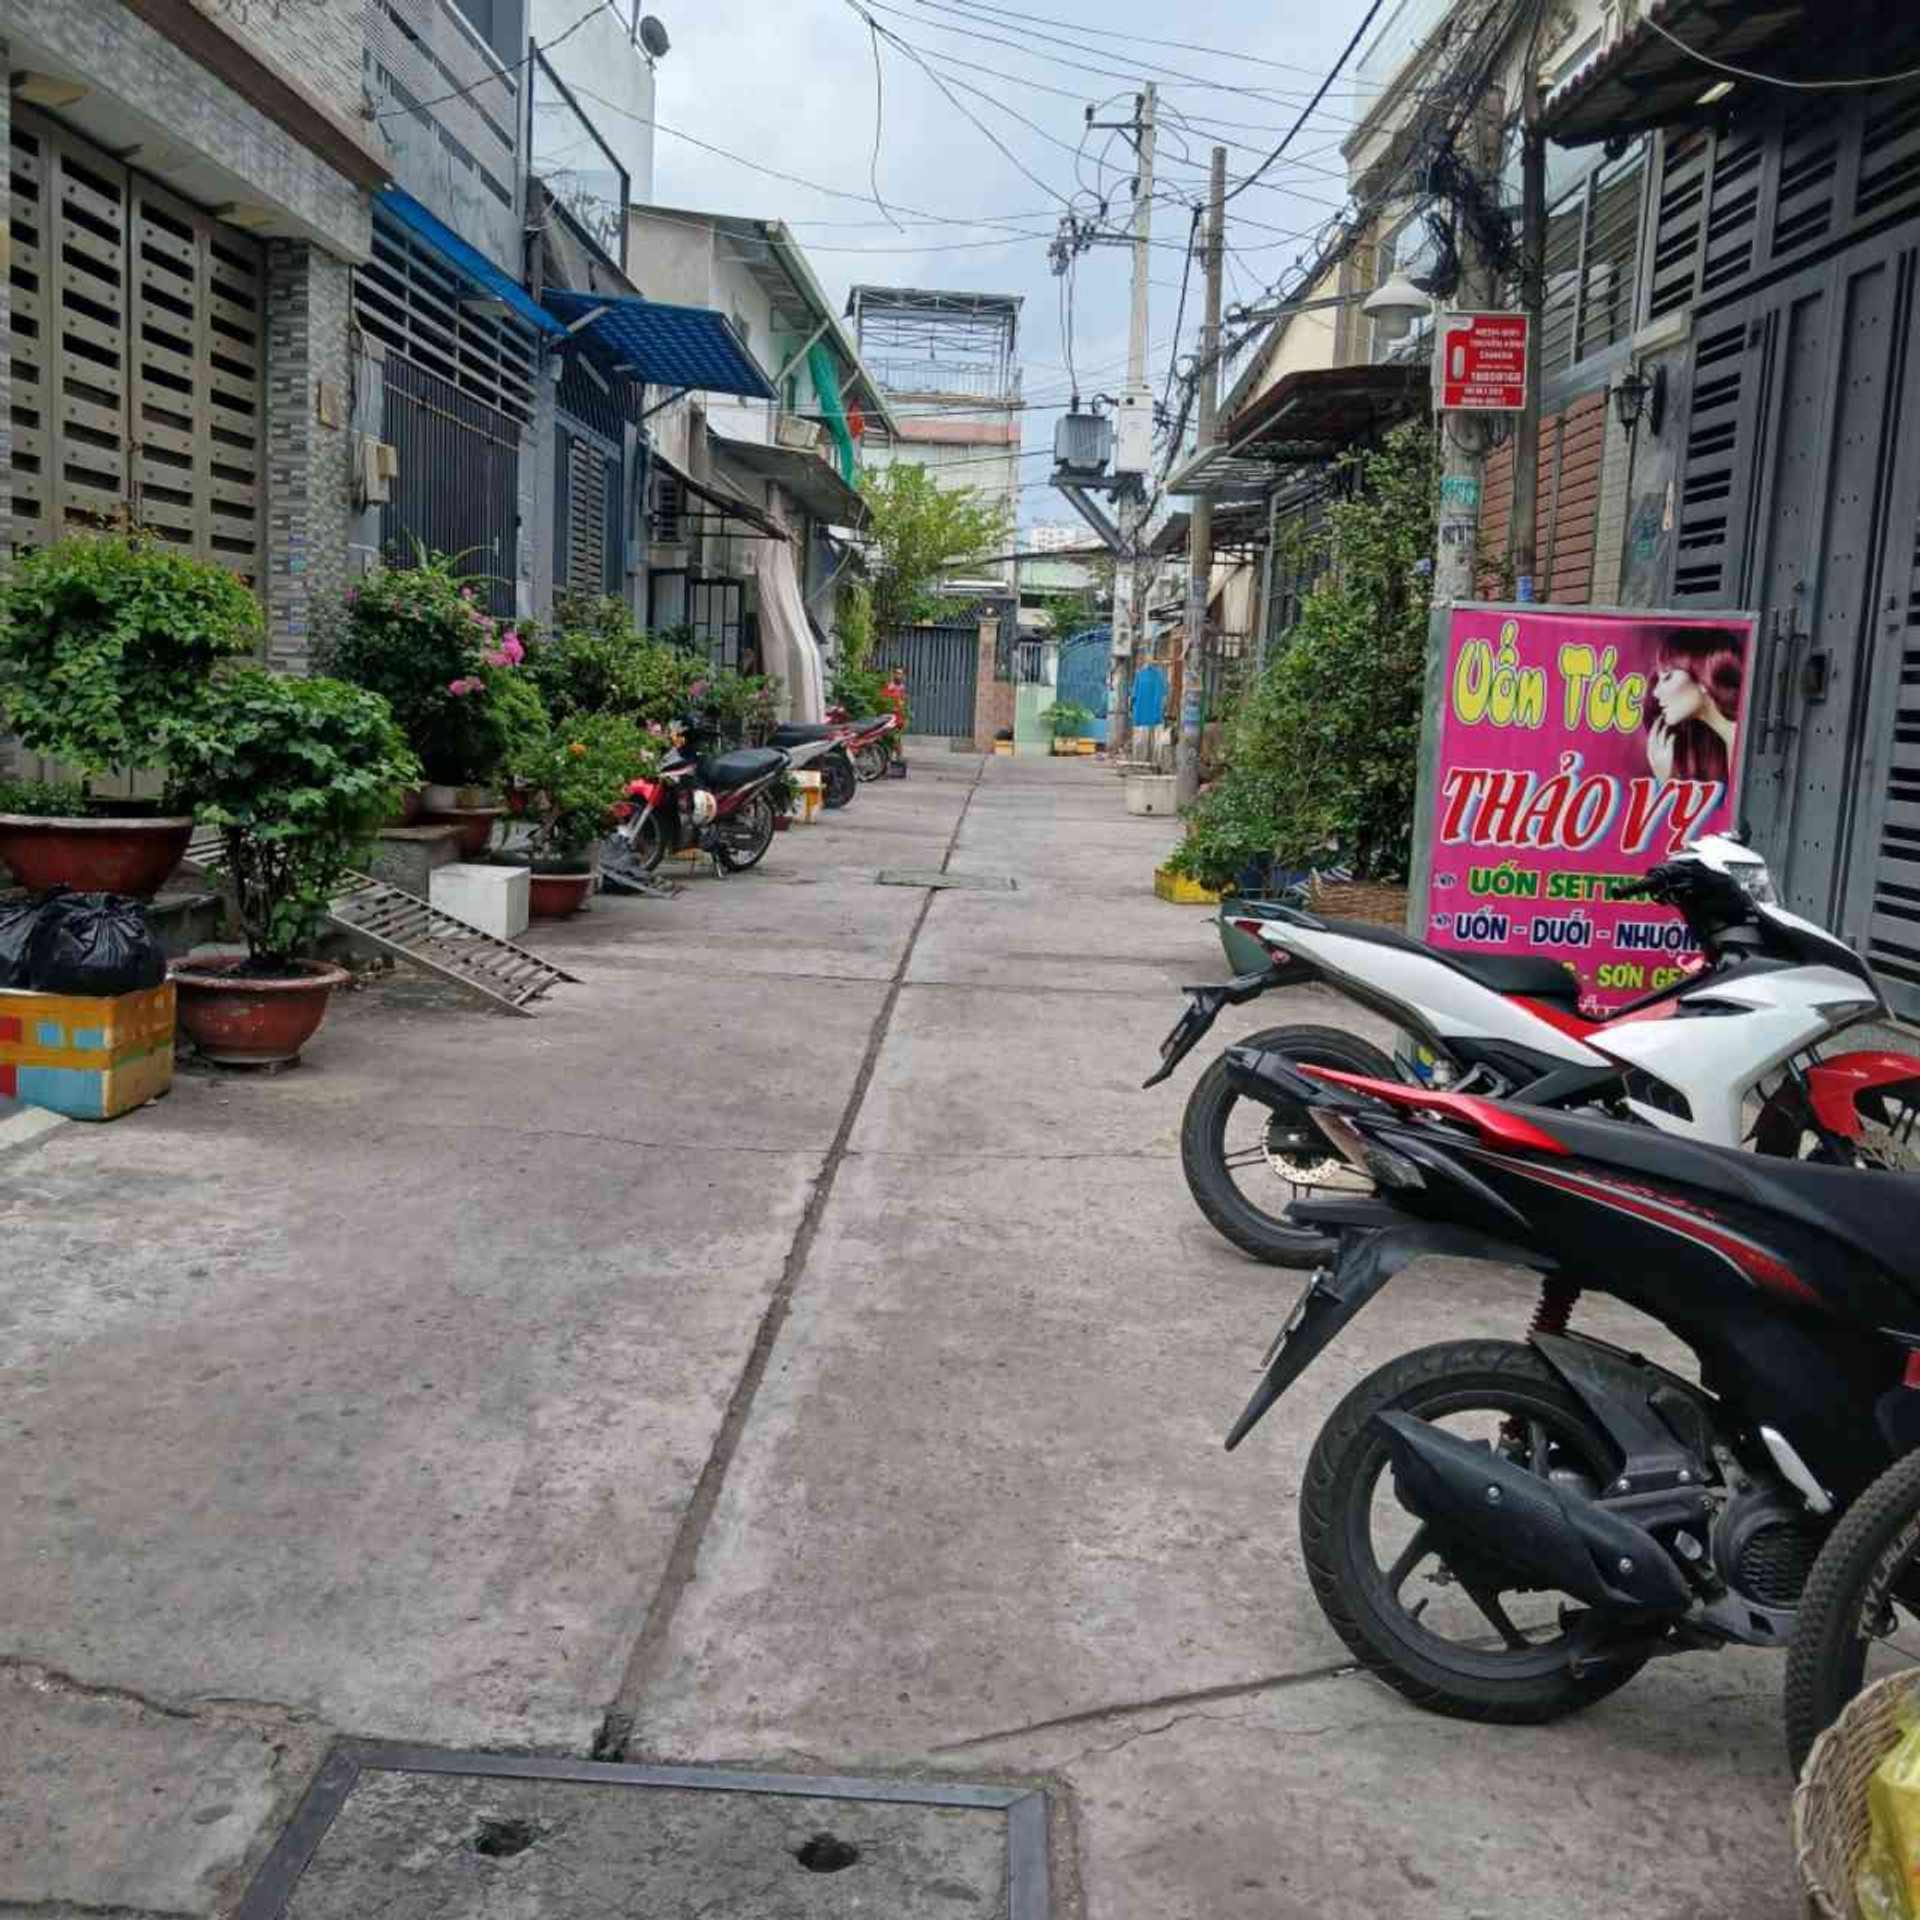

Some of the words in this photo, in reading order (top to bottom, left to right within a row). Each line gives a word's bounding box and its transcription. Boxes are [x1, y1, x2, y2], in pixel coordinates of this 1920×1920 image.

[1453, 619, 1547, 730] Uốn
[1559, 643, 1647, 733] Tóc
[1441, 750, 1618, 852] THẢO
[1620, 777, 1726, 855] VY
[1469, 859, 1541, 899] UỐN
[1454, 905, 1510, 943] UỐN
[1597, 962, 1645, 989] SƠN
